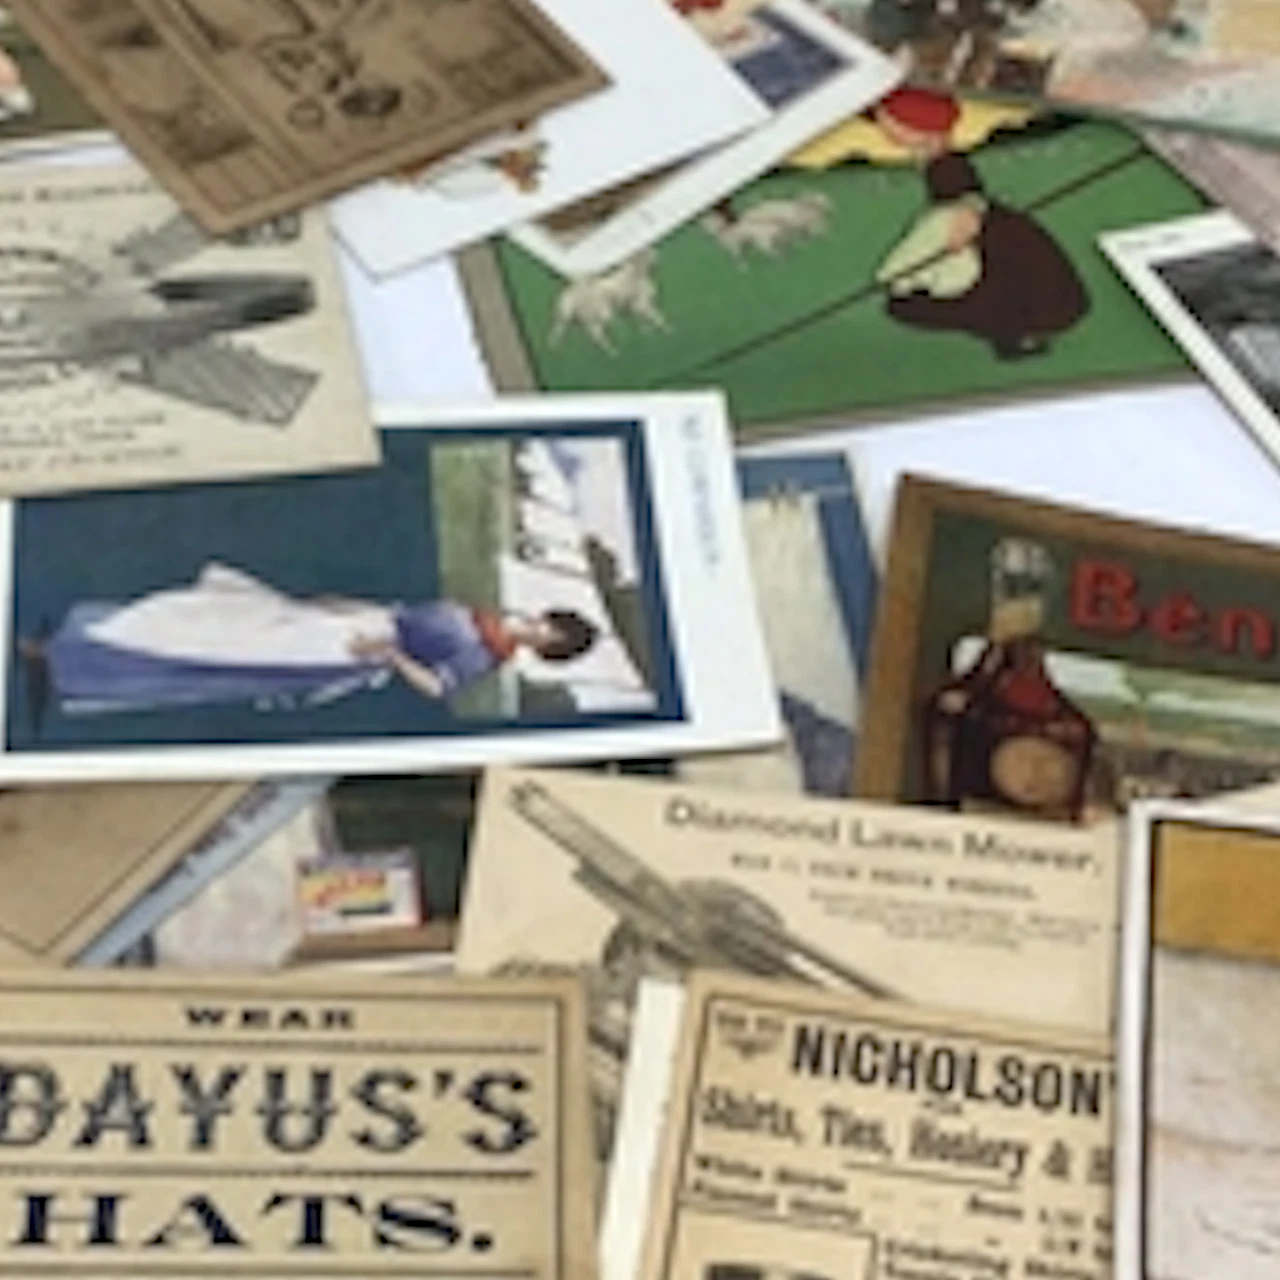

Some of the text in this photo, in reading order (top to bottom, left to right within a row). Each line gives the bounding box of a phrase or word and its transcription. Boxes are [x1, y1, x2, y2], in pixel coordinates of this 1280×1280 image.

[665, 794, 842, 848] Diamond
[851, 817, 953, 858] Lawn
[184, 1008, 357, 1031] WEAR
[13, 1191, 495, 1253] HATS.
